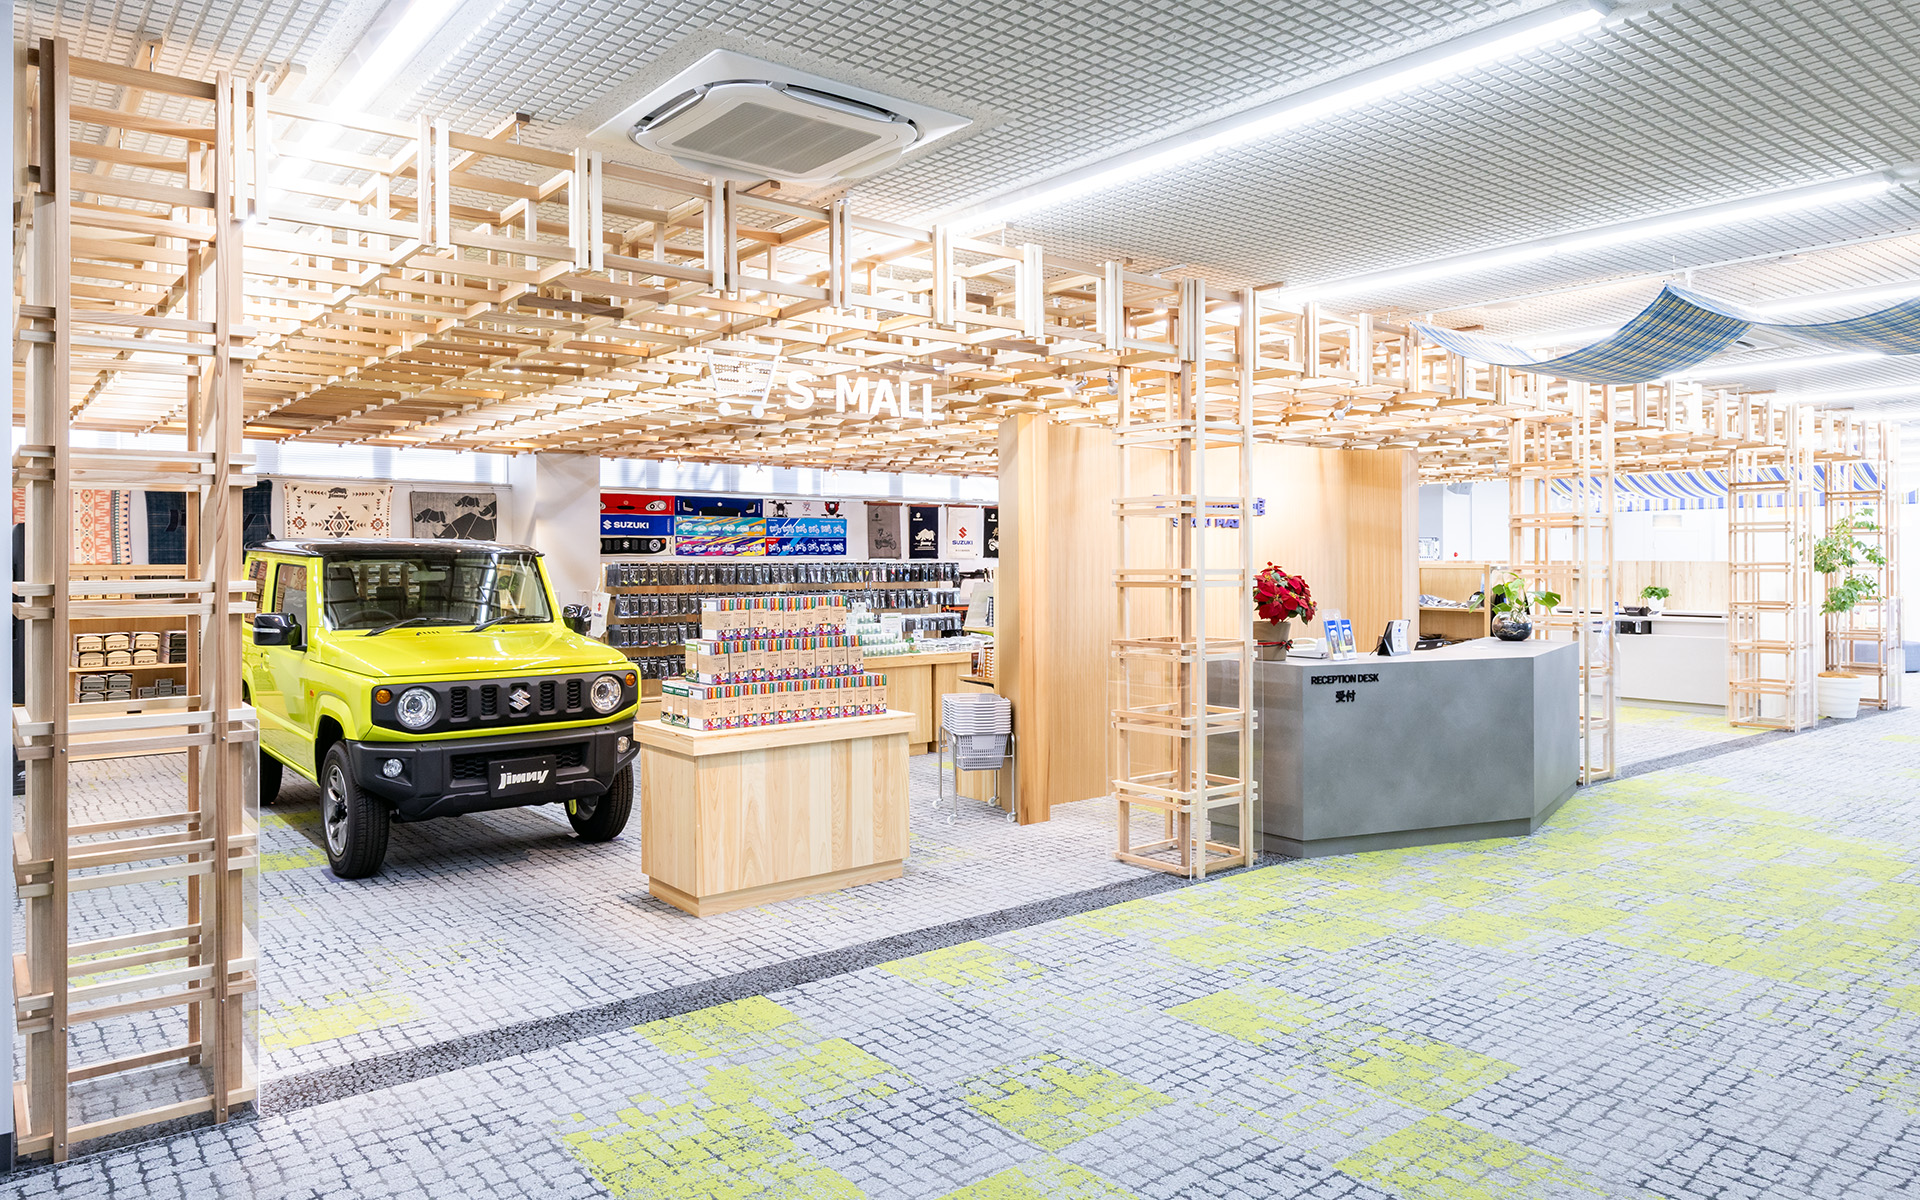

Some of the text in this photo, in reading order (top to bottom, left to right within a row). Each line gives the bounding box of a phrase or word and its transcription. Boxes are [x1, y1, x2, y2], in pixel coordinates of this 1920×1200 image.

[613, 521, 649, 529] SUZUKI
[1311, 673, 1379, 685] RECEPTION DESK
[1335, 690, 1356, 703] 受付
[498, 769, 549, 789] Jimny
